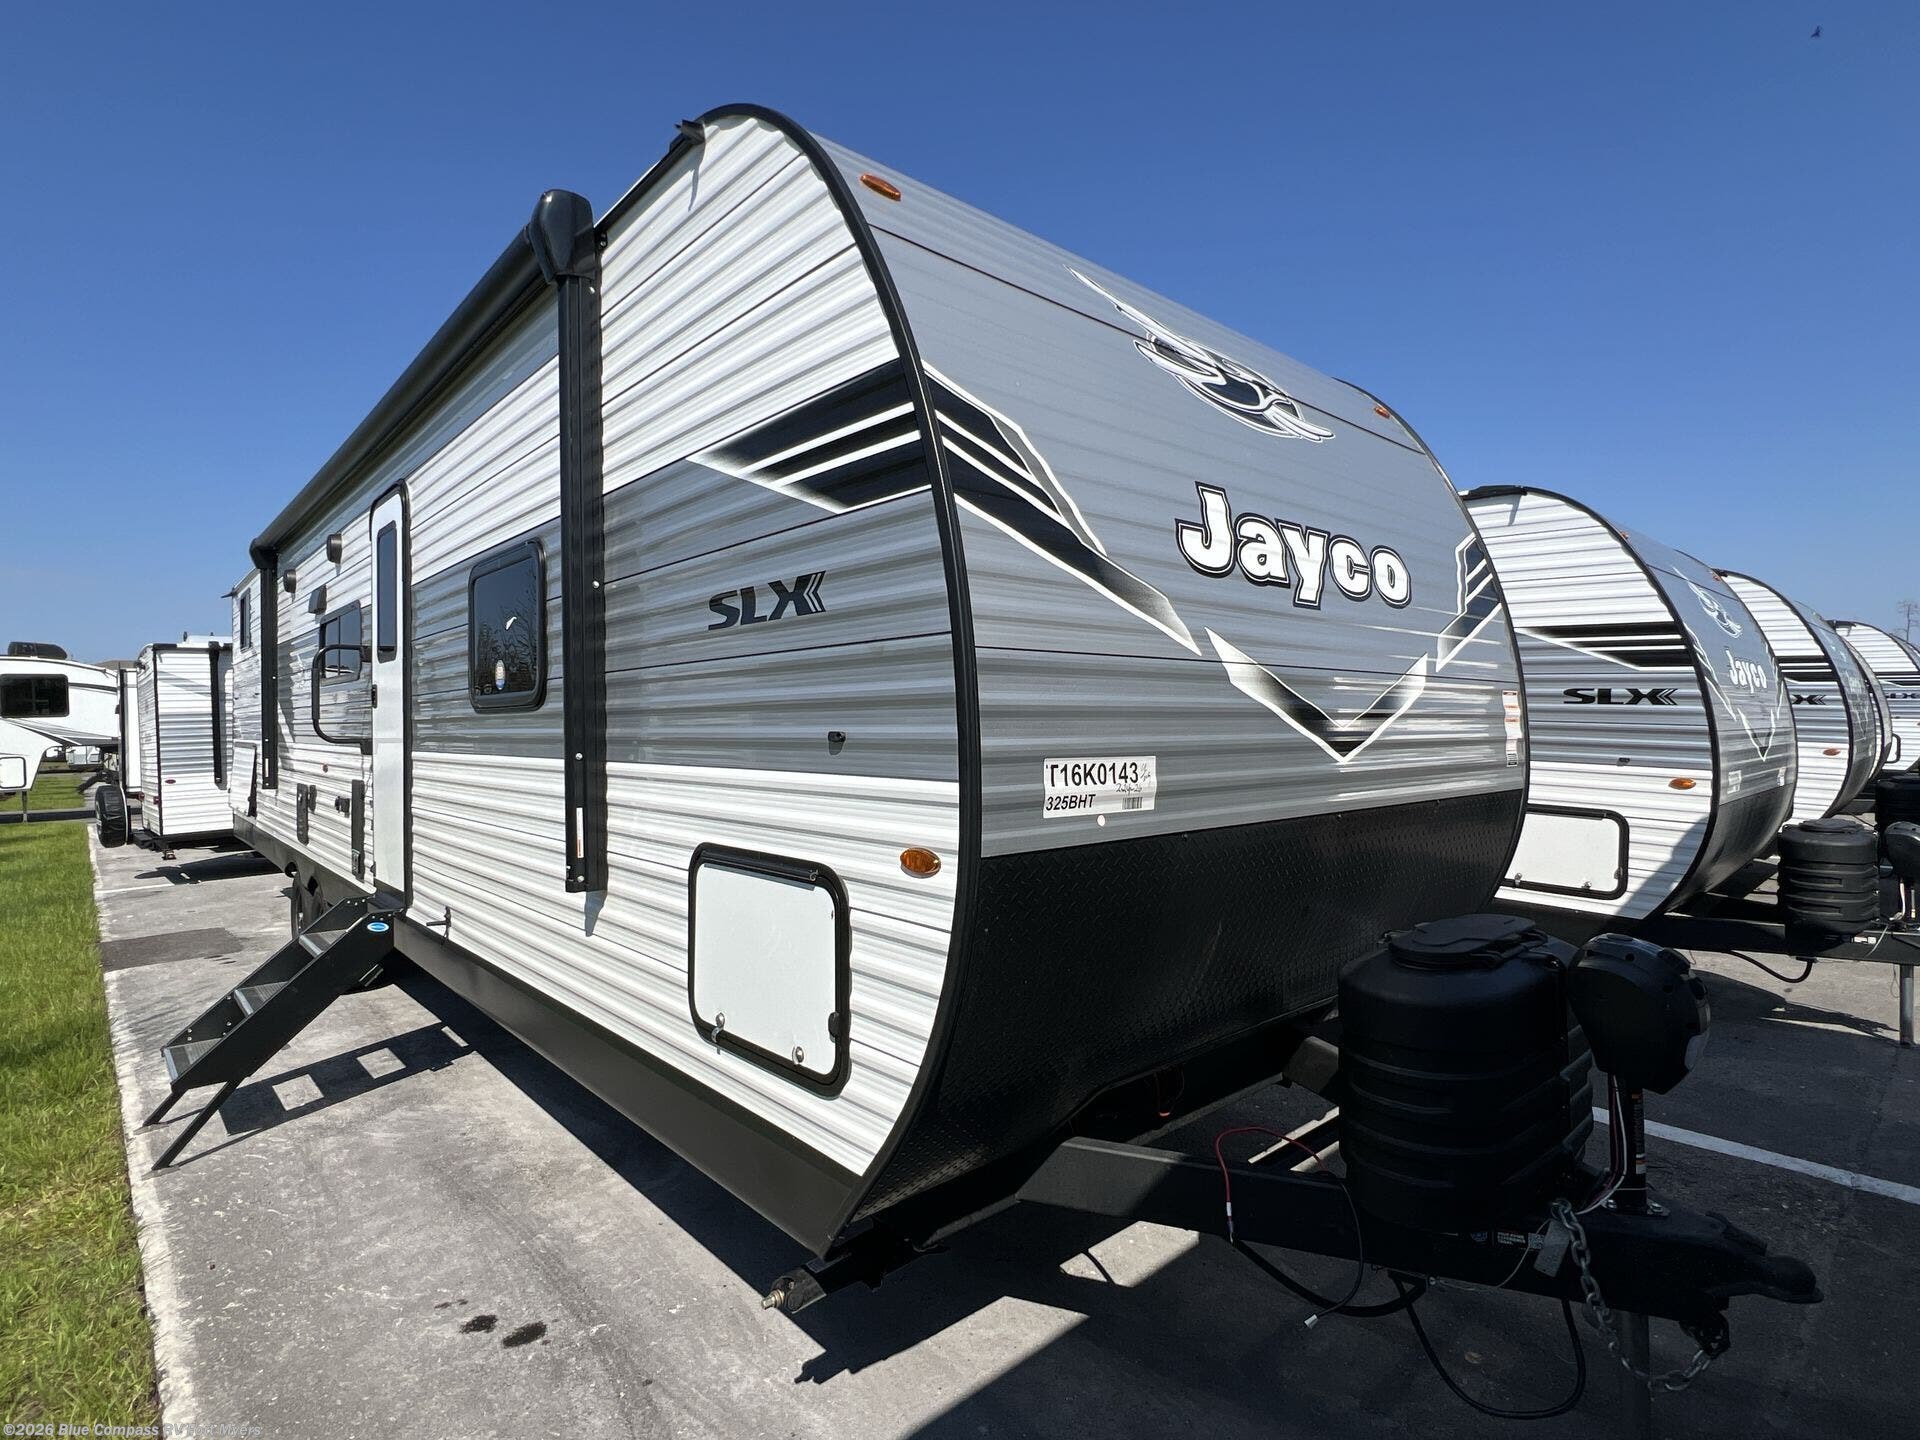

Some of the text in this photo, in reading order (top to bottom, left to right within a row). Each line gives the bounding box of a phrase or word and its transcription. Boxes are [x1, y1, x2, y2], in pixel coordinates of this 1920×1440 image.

[1174, 481, 1411, 610] Jayco
[708, 570, 826, 630] SLX
[1724, 646, 1768, 695] Jayco
[1563, 688, 1678, 705] SLX
[1045, 762, 1139, 787] T16K0143
[1045, 794, 1096, 811] 325BHT
